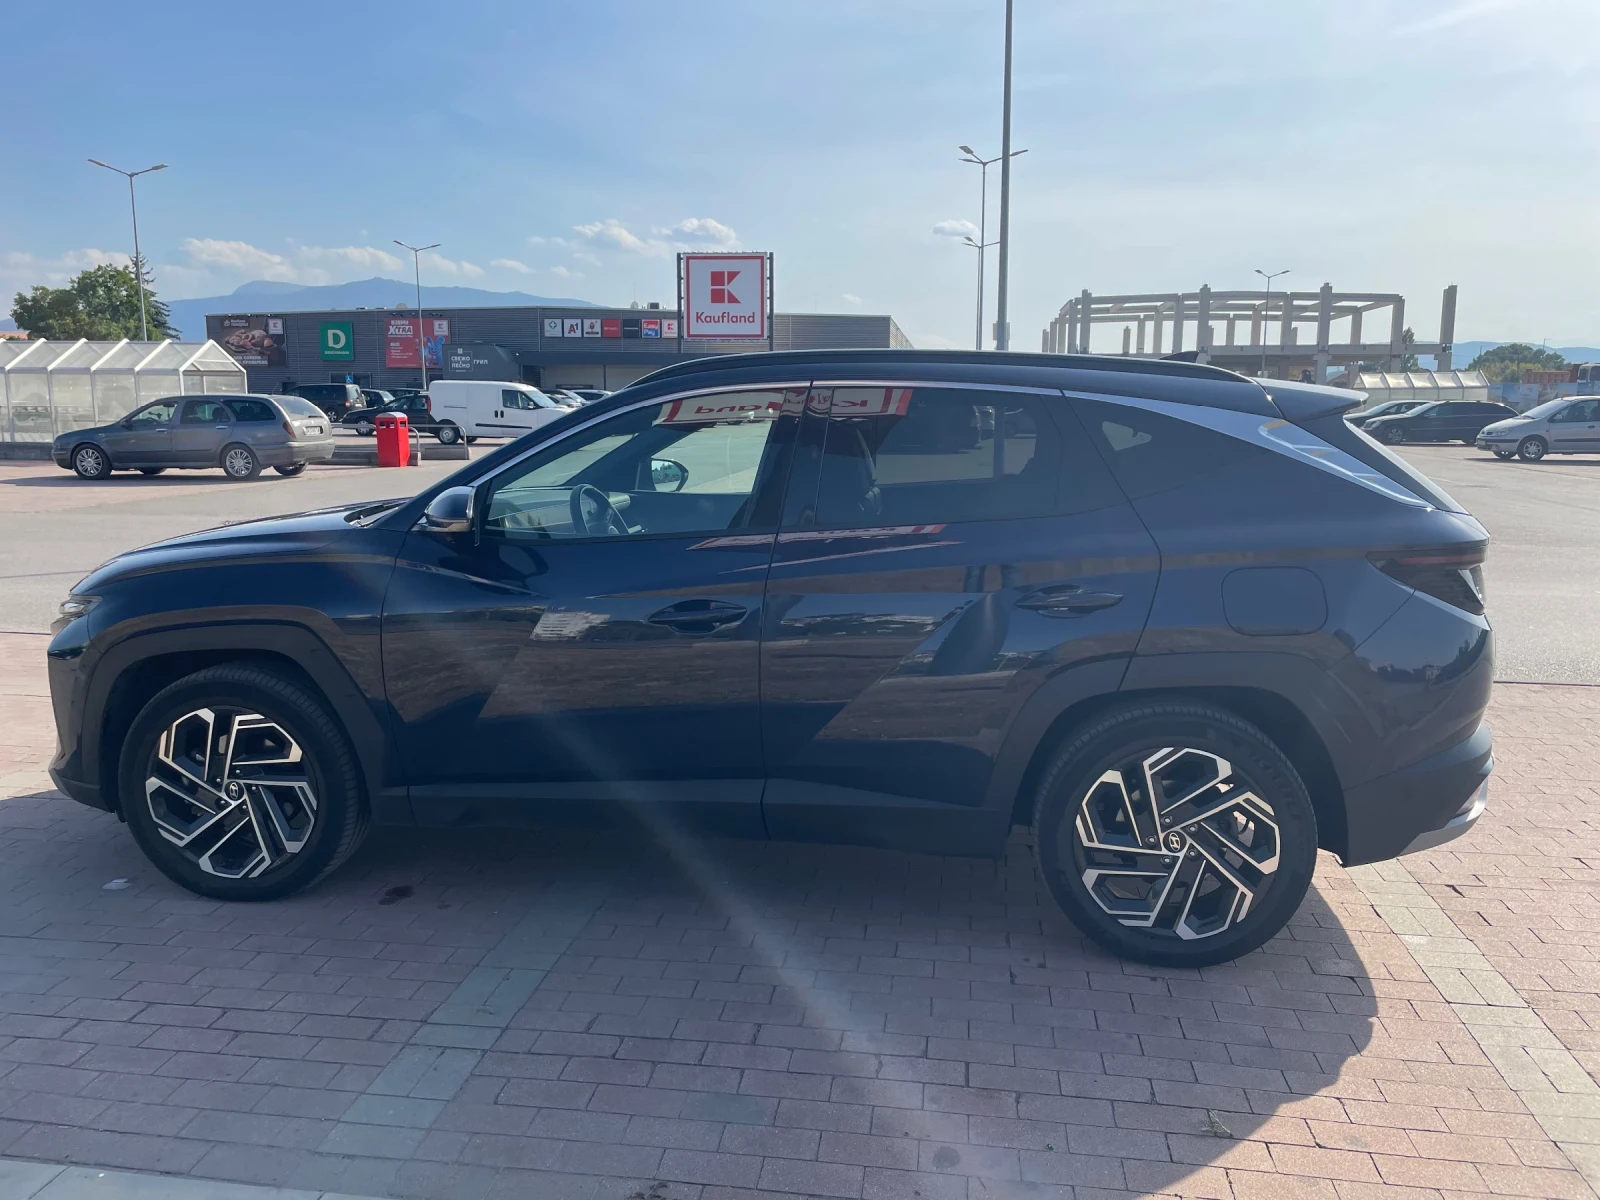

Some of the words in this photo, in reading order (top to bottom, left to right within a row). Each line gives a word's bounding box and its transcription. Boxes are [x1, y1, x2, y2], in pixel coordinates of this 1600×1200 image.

[695, 311, 756, 324] Kaufland
[387, 325, 414, 335] XTRA
[567, 322, 579, 334] A1
[643, 322, 659, 330] Easy
[643, 328, 656, 336] Pay
[327, 329, 347, 349] D
